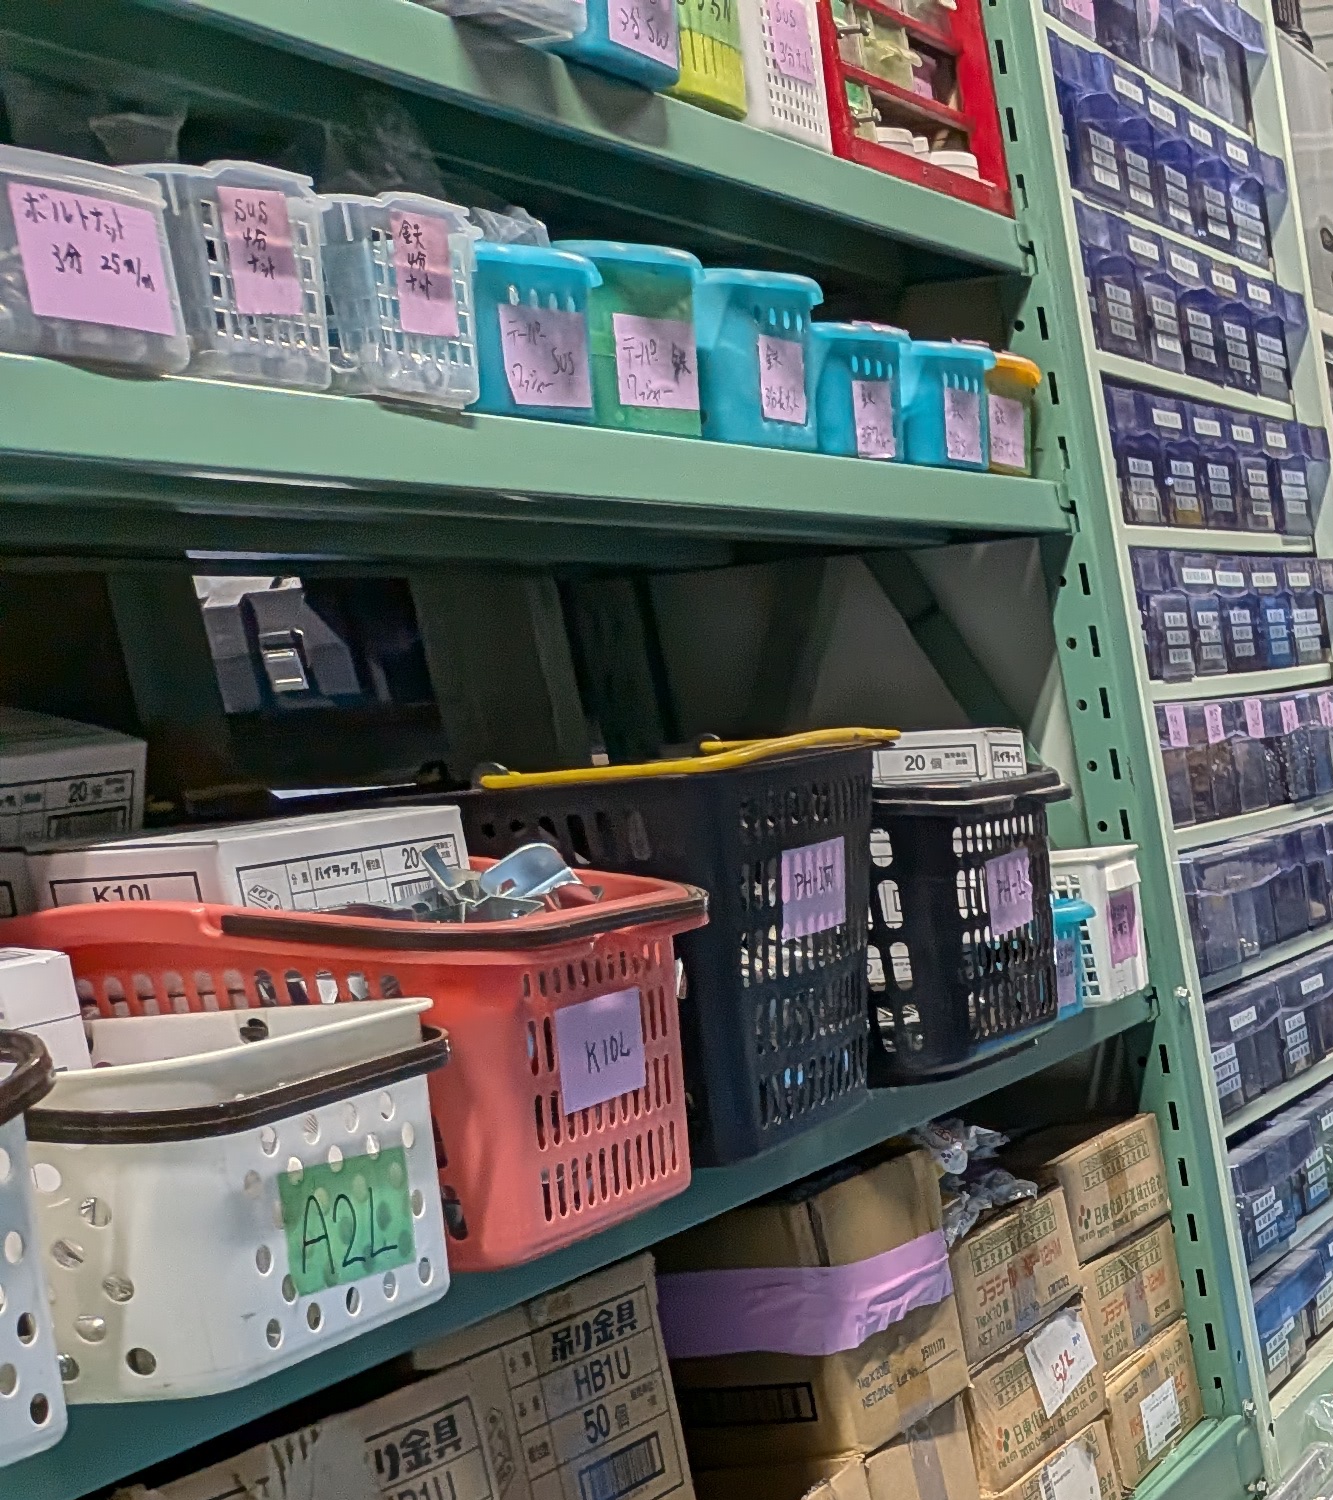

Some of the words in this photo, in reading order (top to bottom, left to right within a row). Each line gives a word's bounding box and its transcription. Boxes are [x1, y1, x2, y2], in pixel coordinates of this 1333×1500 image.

[234, 198, 268, 225] SUS
[550, 346, 576, 376] SUS
[904, 754, 926, 771] 20
[69, 780, 88, 803] 20
[315, 861, 362, 882] パイラック
[401, 846, 421, 871] 20
[585, 1027, 632, 1077] K10L
[301, 1186, 399, 1276] A2L
[551, 1299, 639, 1362] 吊り金具
[573, 1346, 632, 1401] HB1U
[584, 1404, 611, 1444] 50
[374, 1414, 463, 1482] り金具
